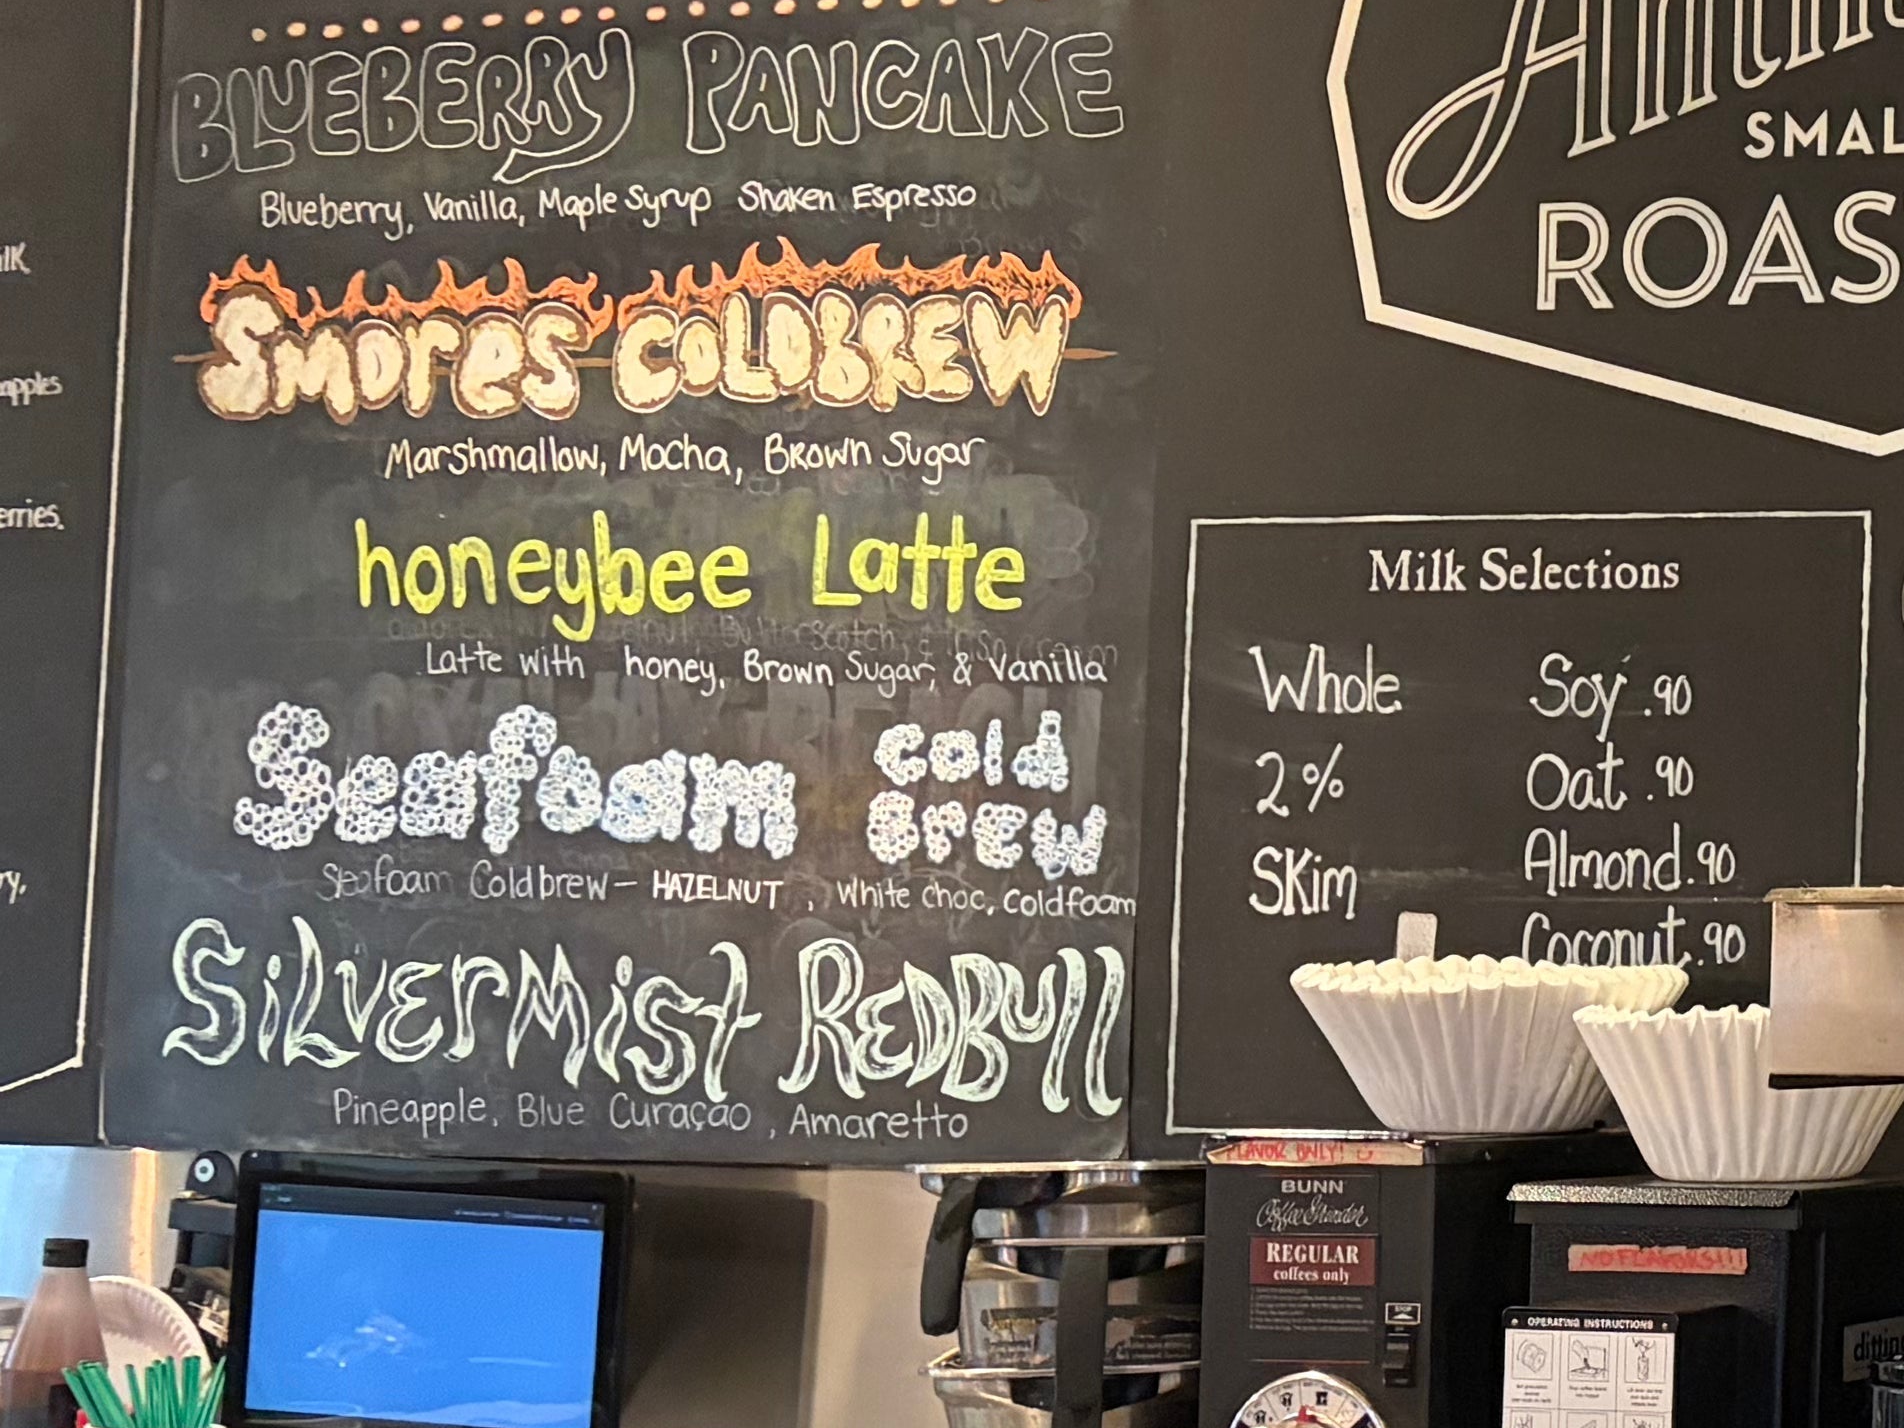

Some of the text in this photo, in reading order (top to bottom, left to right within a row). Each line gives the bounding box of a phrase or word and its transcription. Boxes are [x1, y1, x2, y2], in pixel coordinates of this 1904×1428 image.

[171, 26, 1124, 184] BLUEBERRY PANCAKE
[261, 191, 413, 240] Blueberry,
[539, 183, 617, 231] Maple
[625, 185, 711, 228] Syrup
[738, 181, 835, 212] Shaken
[852, 183, 976, 221] Espresso
[385, 436, 606, 478] Marshmallow,
[883, 431, 985, 485] Sugar
[353, 509, 1028, 642] honeybee Latte
[1369, 548, 1679, 591] Milk Selections
[427, 641, 502, 674] Latte
[520, 644, 584, 678] with
[744, 649, 833, 686] Brown
[950, 650, 974, 689] &
[988, 645, 1110, 686] Vanilla
[1248, 644, 1402, 714] Whole
[1530, 652, 1633, 744] Soy
[234, 701, 1069, 857] Seafoam cold
[1256, 743, 1343, 817] 2%
[1527, 742, 1627, 810] Oat
[1525, 822, 1681, 896] Almond
[651, 874, 788, 913] HAZELNUT
[835, 873, 913, 911] White
[516, 1089, 587, 1131] Blue
[788, 1099, 971, 1142] Amaretto
[1280, 1179, 1344, 1194] BUNN
[1265, 1241, 1360, 1265] REGULAR
[1272, 1265, 1350, 1285] coffees only
[1526, 1316, 1655, 1330] OPERATING INSTRUCTIONS
